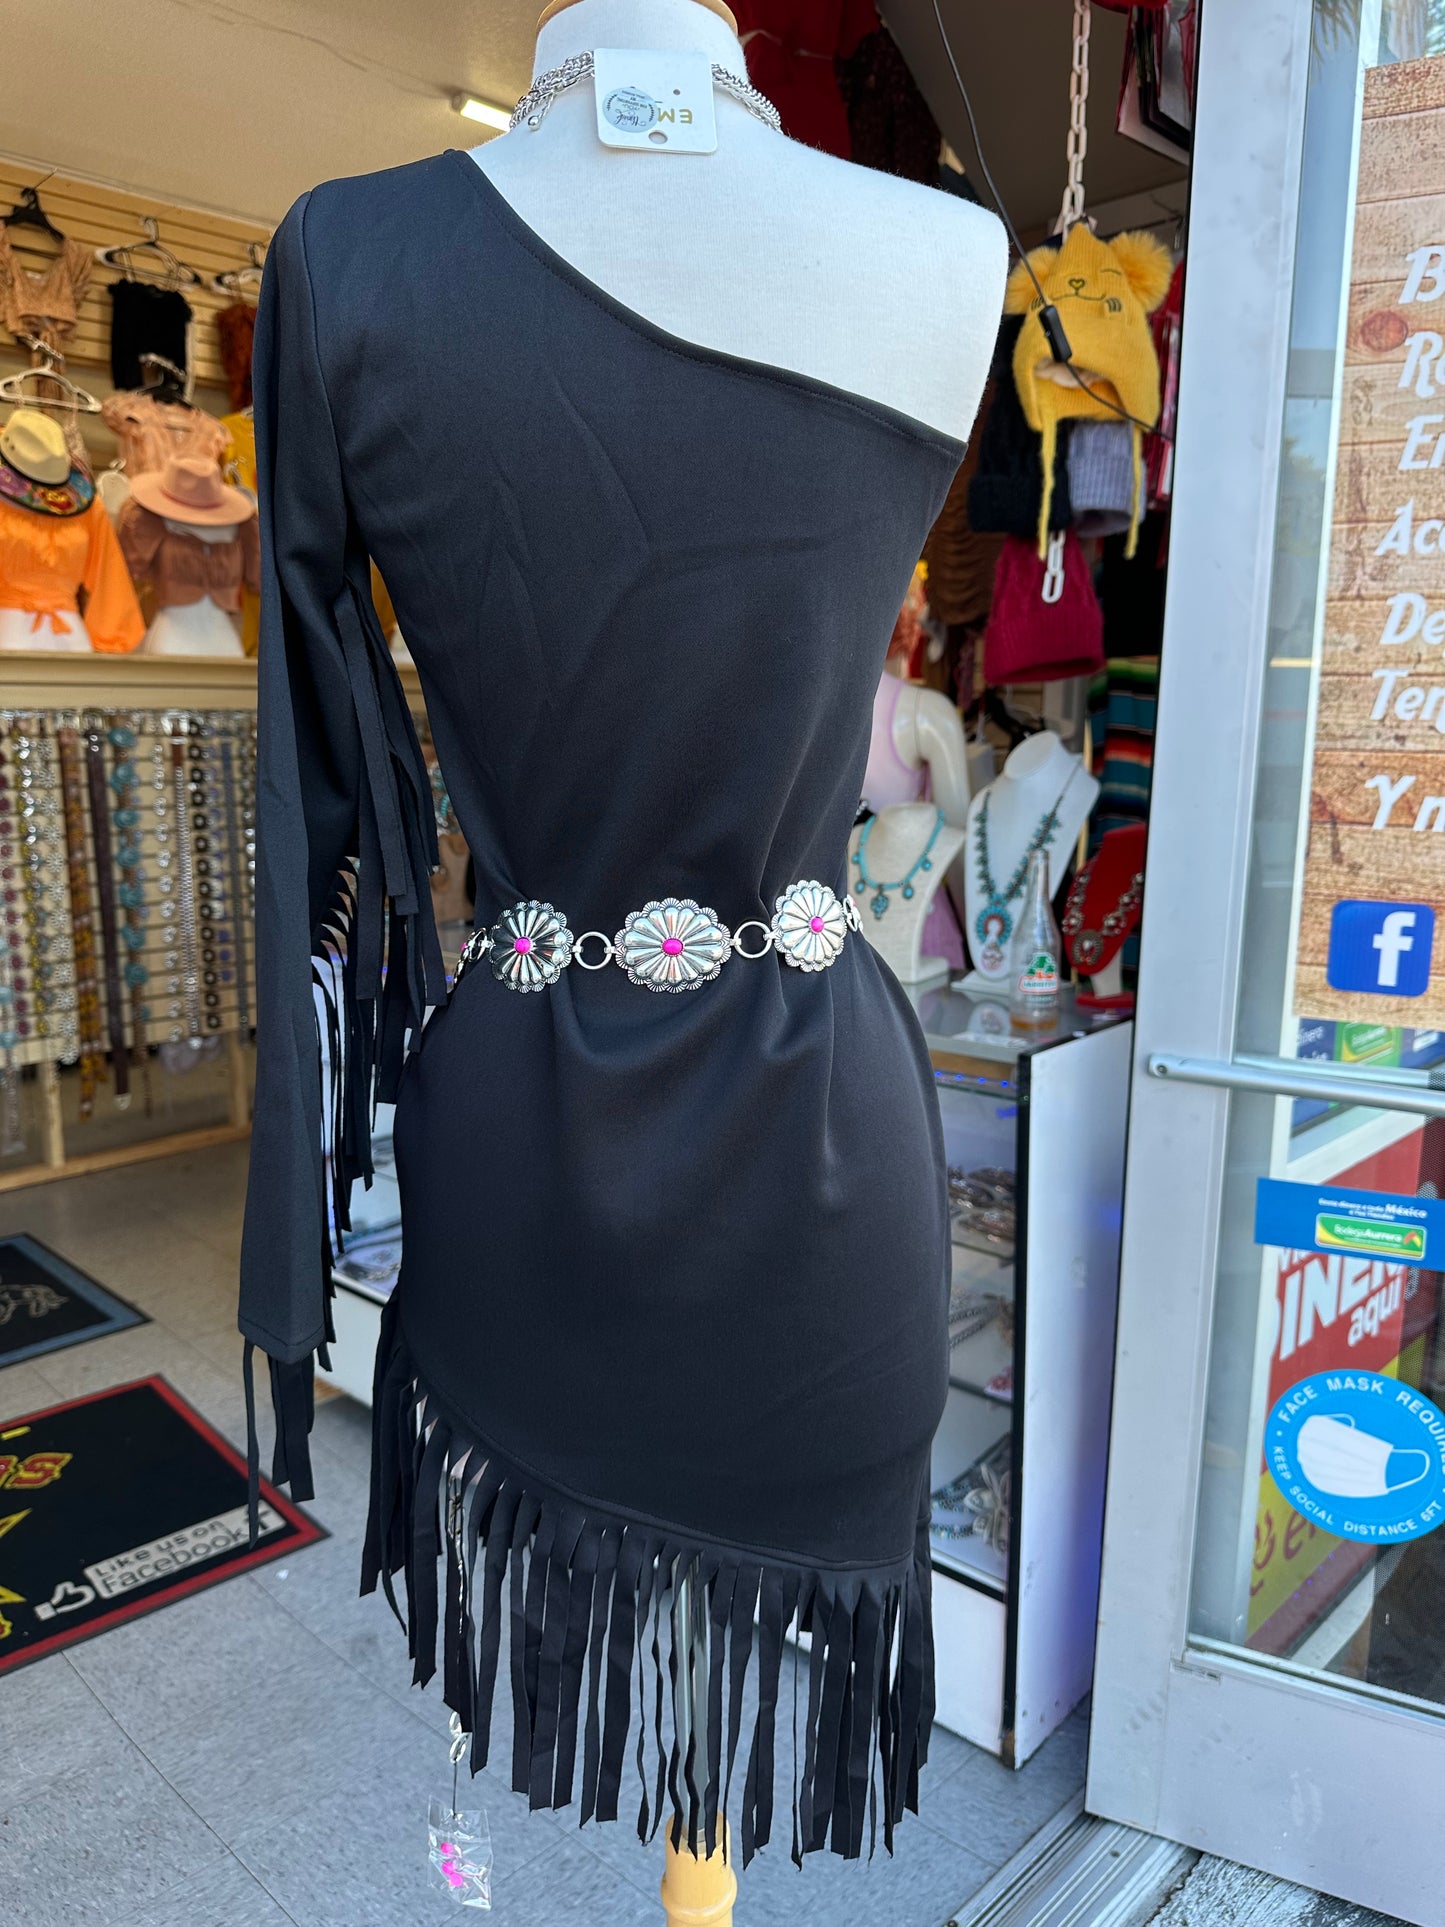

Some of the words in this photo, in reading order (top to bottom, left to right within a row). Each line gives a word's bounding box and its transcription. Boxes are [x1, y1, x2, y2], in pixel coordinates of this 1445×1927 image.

[1374, 497, 1445, 556] Ac
[1379, 592, 1445, 648] De
[1277, 1384, 1318, 1424] FACE
[1325, 1376, 1385, 1396] MASK
[1272, 1445, 1292, 1481] KEEP
[1289, 1485, 1335, 1526] SOCIAL
[1343, 1518, 1418, 1537] DISTANCE
[1420, 1499, 1443, 1523] 6FT
[95, 1549, 150, 1577] Like
[156, 1534, 189, 1552] us
[192, 1520, 226, 1539] on
[100, 1526, 250, 1594] Facebook
